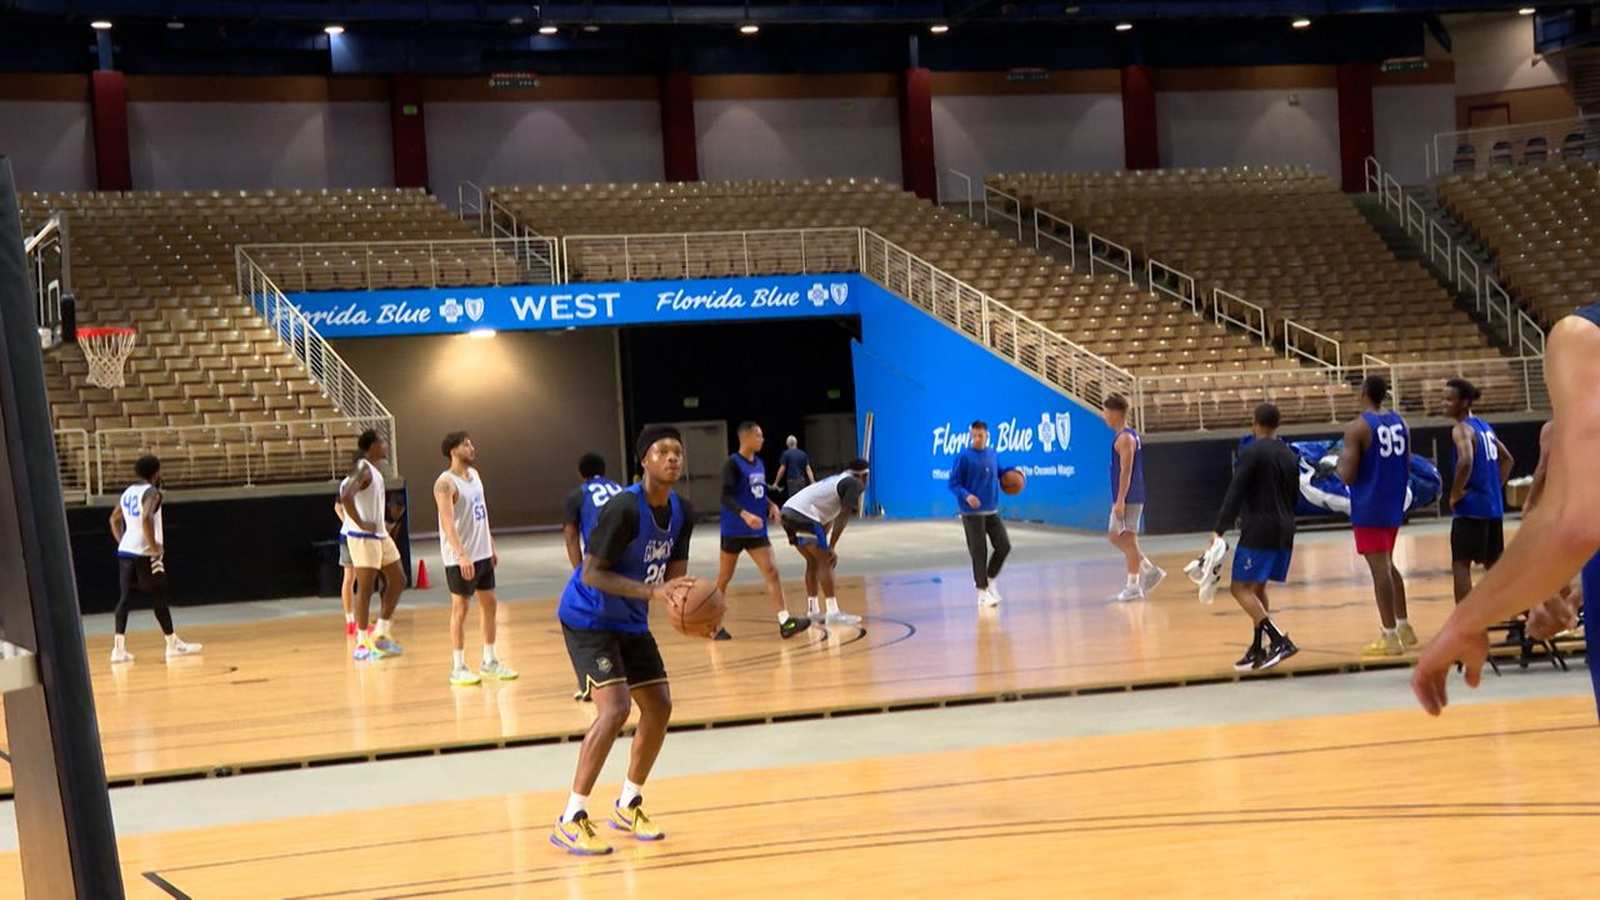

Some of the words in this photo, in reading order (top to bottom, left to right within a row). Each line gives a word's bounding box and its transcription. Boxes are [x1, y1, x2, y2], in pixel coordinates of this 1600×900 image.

[376, 301, 432, 325] Blue
[510, 292, 621, 321] WEST
[656, 287, 746, 312] Florida
[750, 285, 801, 308] Blue
[932, 422, 994, 456] Flori
[996, 416, 1034, 453] Blue
[1377, 423, 1406, 458] 95
[1480, 430, 1499, 461] 16
[122, 494, 140, 517] 42
